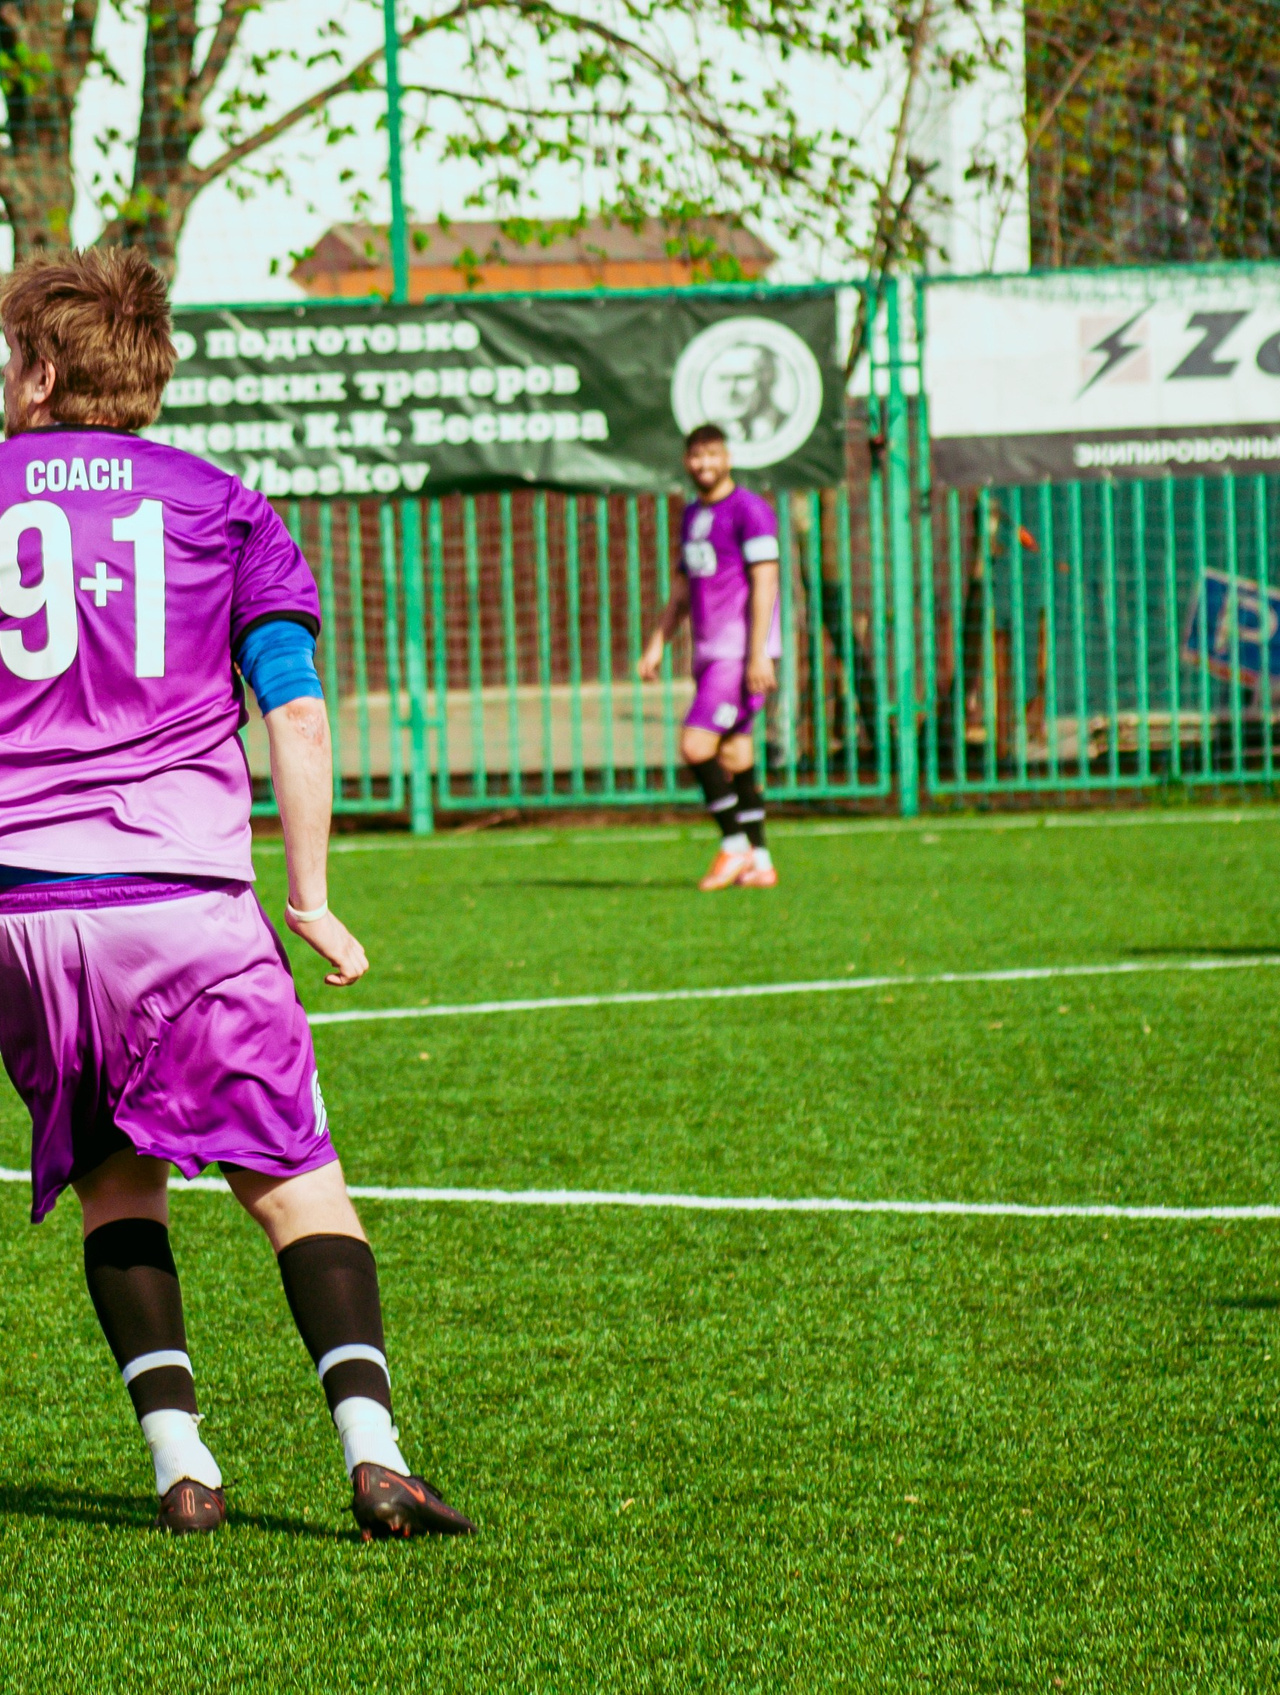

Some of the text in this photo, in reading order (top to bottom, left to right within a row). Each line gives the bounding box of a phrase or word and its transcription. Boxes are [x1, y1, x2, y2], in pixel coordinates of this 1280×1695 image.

[204, 320, 480, 362] подготовке
[164, 363, 581, 408] шеских тренеров
[409, 408, 610, 447] Бескова
[1074, 434, 1280, 468] ЭКИПИРОВОЧНЫ
[25, 457, 133, 495] COACH
